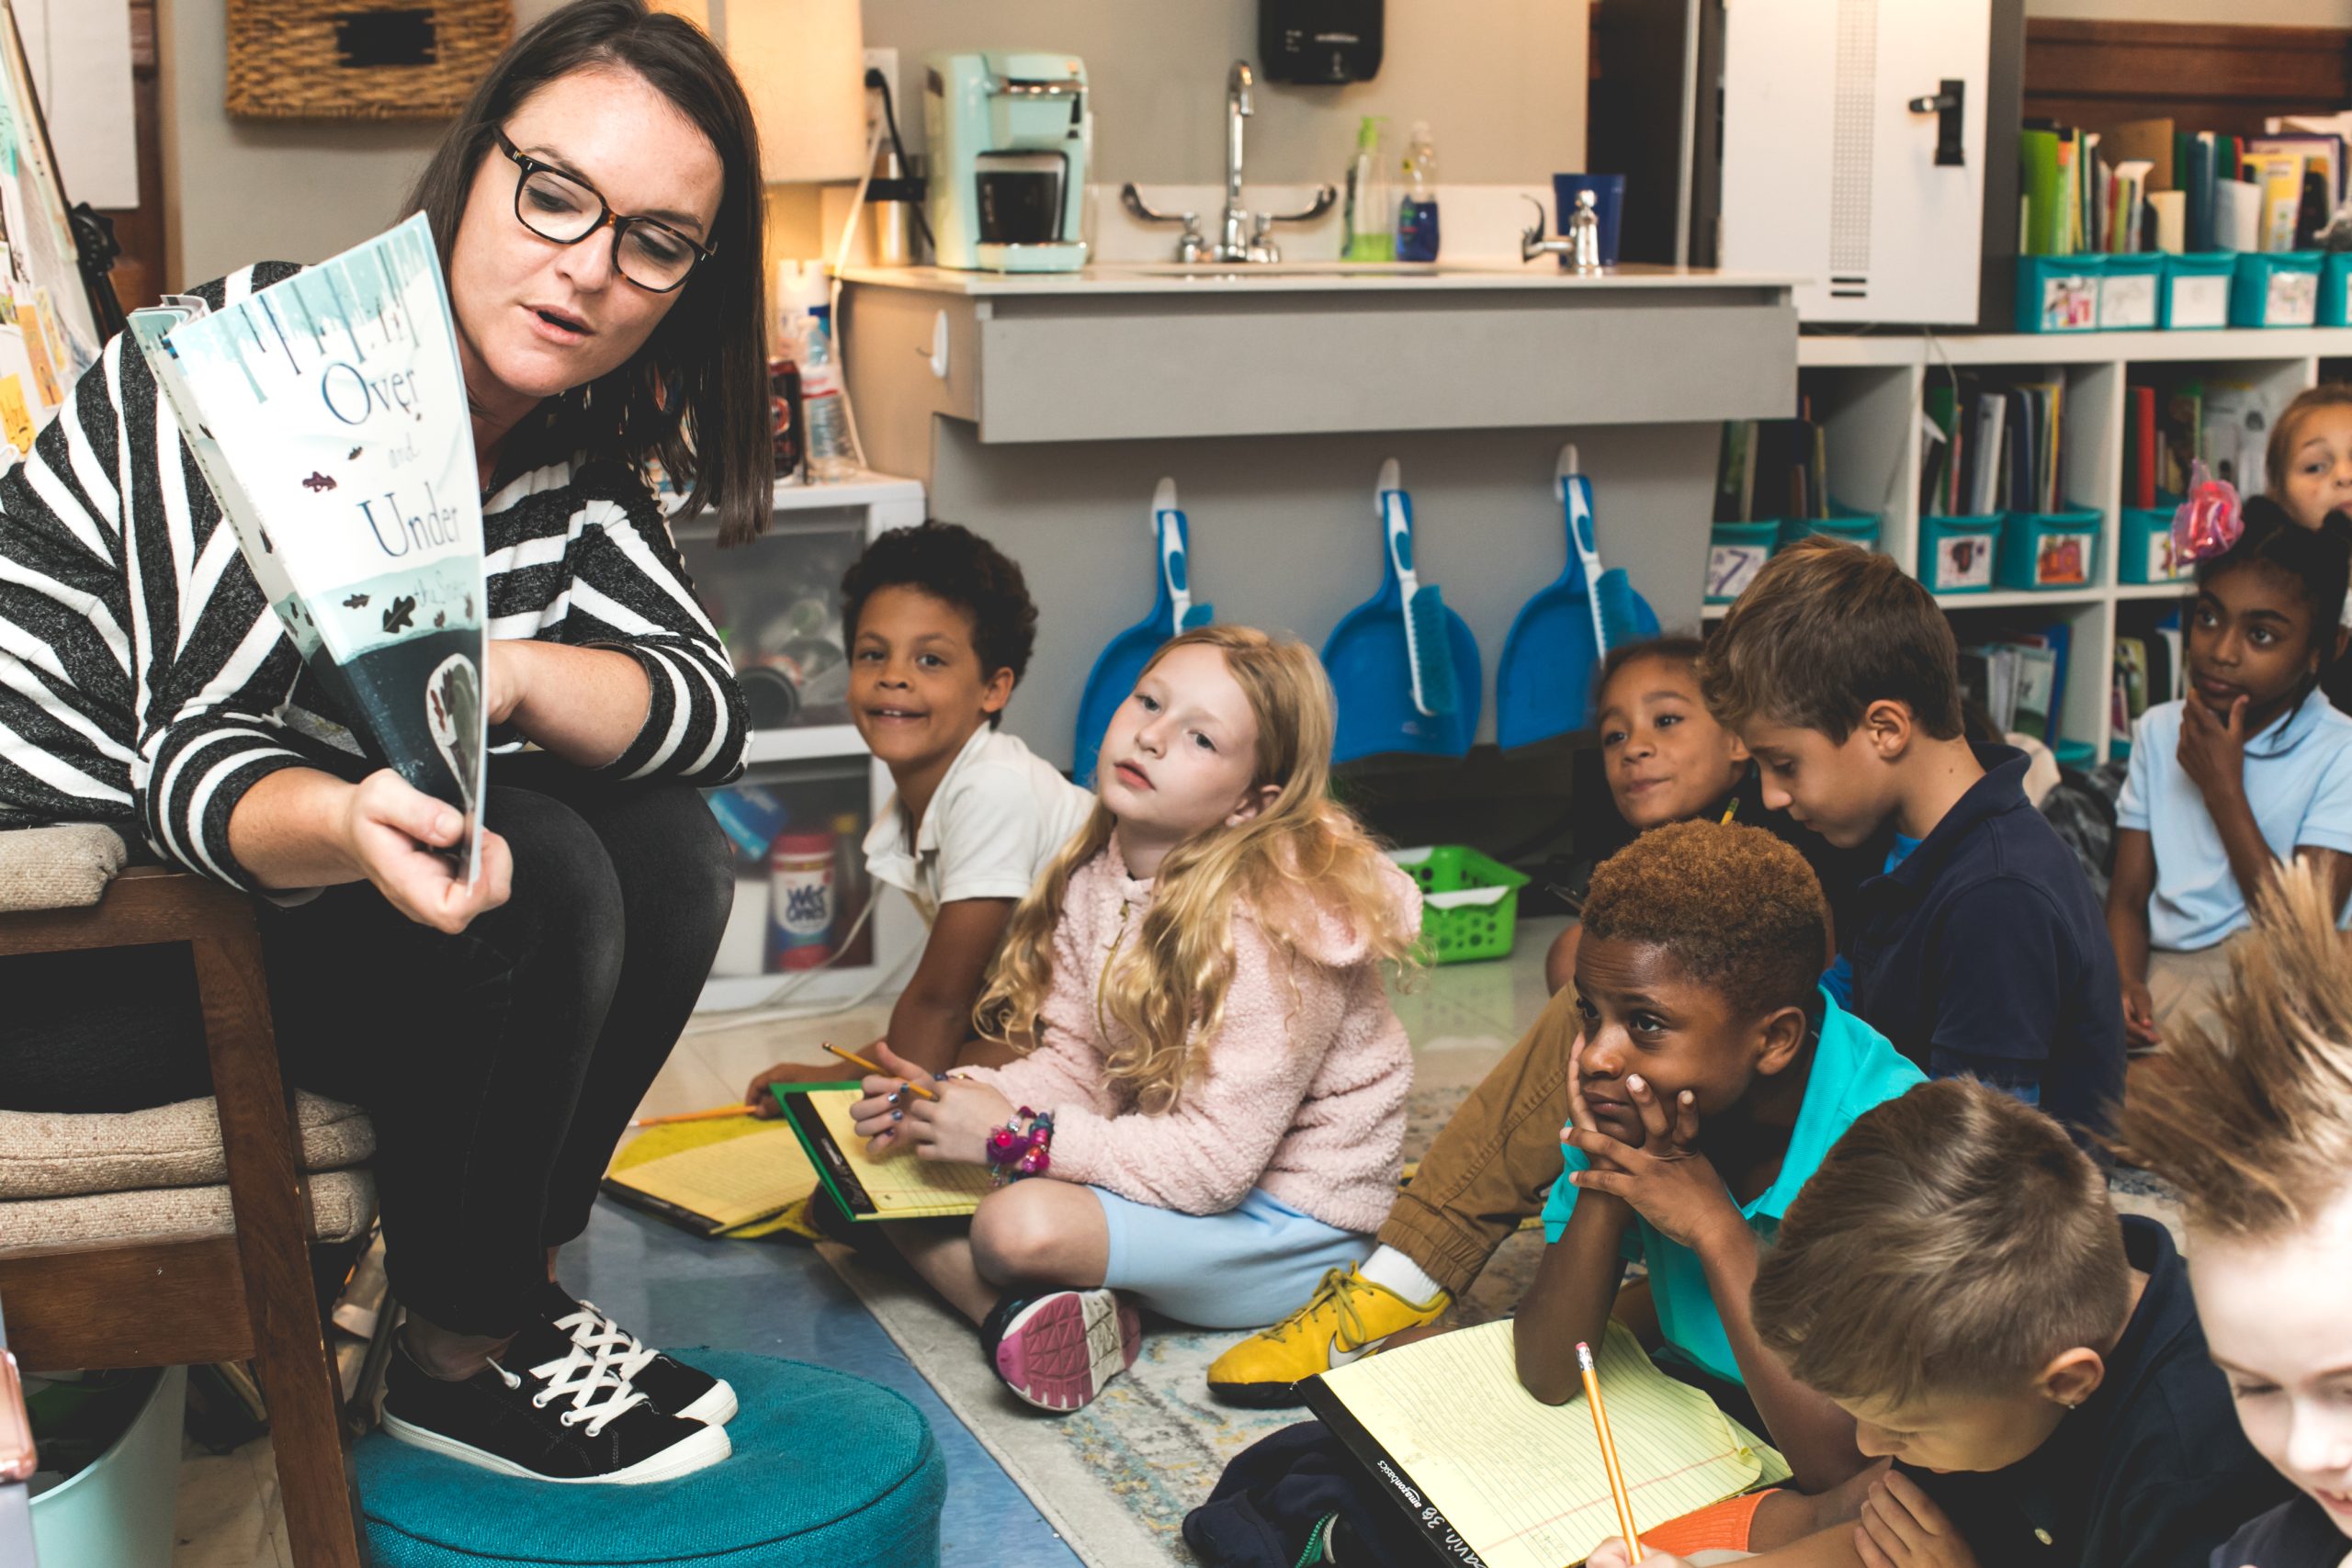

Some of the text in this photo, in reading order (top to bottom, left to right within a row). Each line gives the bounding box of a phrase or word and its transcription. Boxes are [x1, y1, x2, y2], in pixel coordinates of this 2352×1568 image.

[322, 363, 420, 424] Over
[356, 480, 460, 557] Under
[1377, 1460, 1422, 1508] amazonbasics
